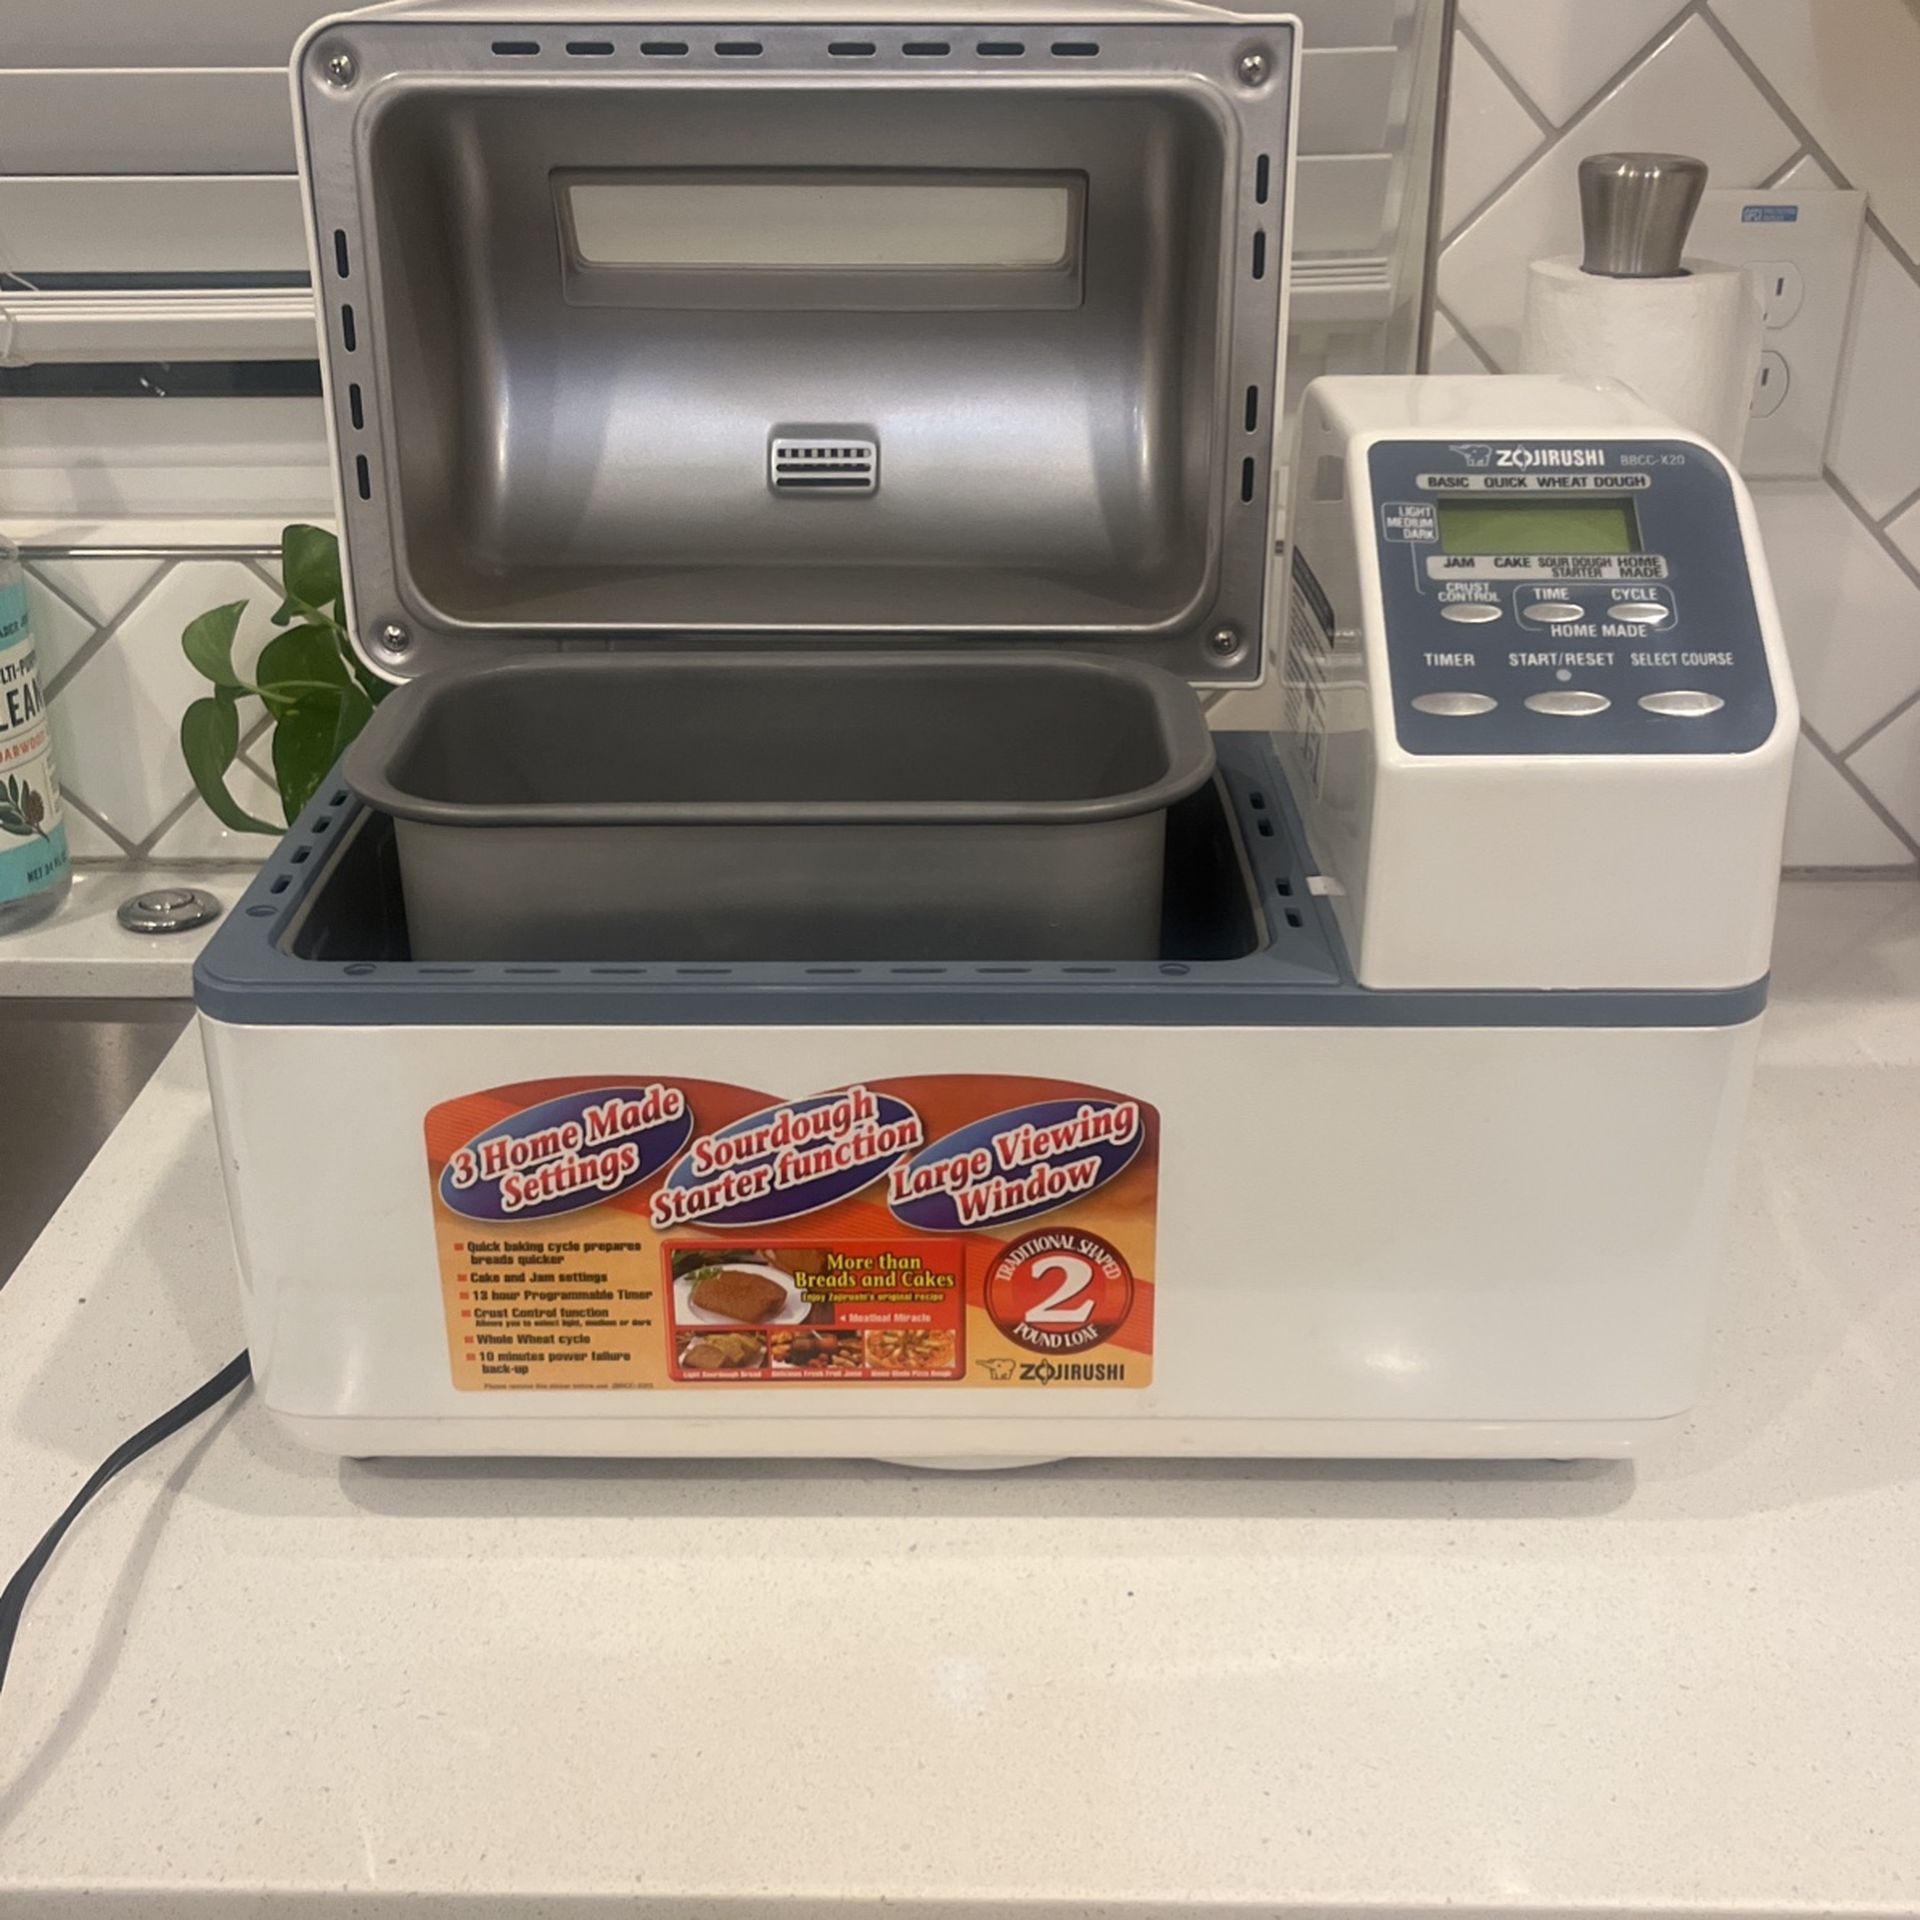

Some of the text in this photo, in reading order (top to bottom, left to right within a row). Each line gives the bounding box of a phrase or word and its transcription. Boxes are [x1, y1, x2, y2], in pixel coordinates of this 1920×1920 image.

[1495, 446, 1686, 470] ZOJIRUSHI BBCC-X20
[1427, 476, 1647, 488] BASIC QUICK WHEAT DOUGH
[1398, 506, 1431, 517] LIGHT
[1386, 517, 1434, 528] MEDIUM
[1403, 528, 1435, 539] DARK
[1443, 557, 1475, 568] JAM
[1494, 557, 1532, 568] CAKE
[1617, 557, 1660, 567] HOME
[1552, 567, 1663, 578] STARTER MADE
[1446, 582, 1489, 592] CRUST
[1438, 591, 1500, 602] CONTROL
[1533, 588, 1658, 600] TIME CYCLE
[1550, 624, 1648, 637] HOME MADE
[1424, 652, 1734, 666] TIMER START/RESET SELECT COURSE
[453, 1086, 681, 1186] 3 Home Made
[694, 1088, 874, 1173] Sourdough
[892, 1106, 1135, 1201] Large Viewing
[502, 1142, 638, 1209] Settings
[653, 1120, 919, 1225] Starter function
[958, 1159, 1098, 1222] Window
[467, 1241, 642, 1253] Quick baking cycle prepares
[471, 1254, 564, 1266] breads quicker
[827, 1253, 921, 1270] More than
[994, 1235, 1122, 1281] TRADITIONAL SHAPED
[470, 1272, 608, 1283] Cake and Jam settings
[795, 1270, 954, 1288] Breads and Cakes
[1025, 1255, 1095, 1322] 2
[492, 1290, 521, 1300] hour
[524, 1289, 614, 1301] Programmable
[618, 1289, 653, 1300] Timer
[474, 1307, 609, 1318] Crust Control function
[477, 1334, 591, 1345] Whole Wheat cycle
[1013, 1322, 1099, 1348] POUND LOAF
[480, 1351, 631, 1363] 10 minutes power failure
[482, 1364, 529, 1375] back-up
[1019, 1359, 1125, 1385] ZOJIRUSHI
